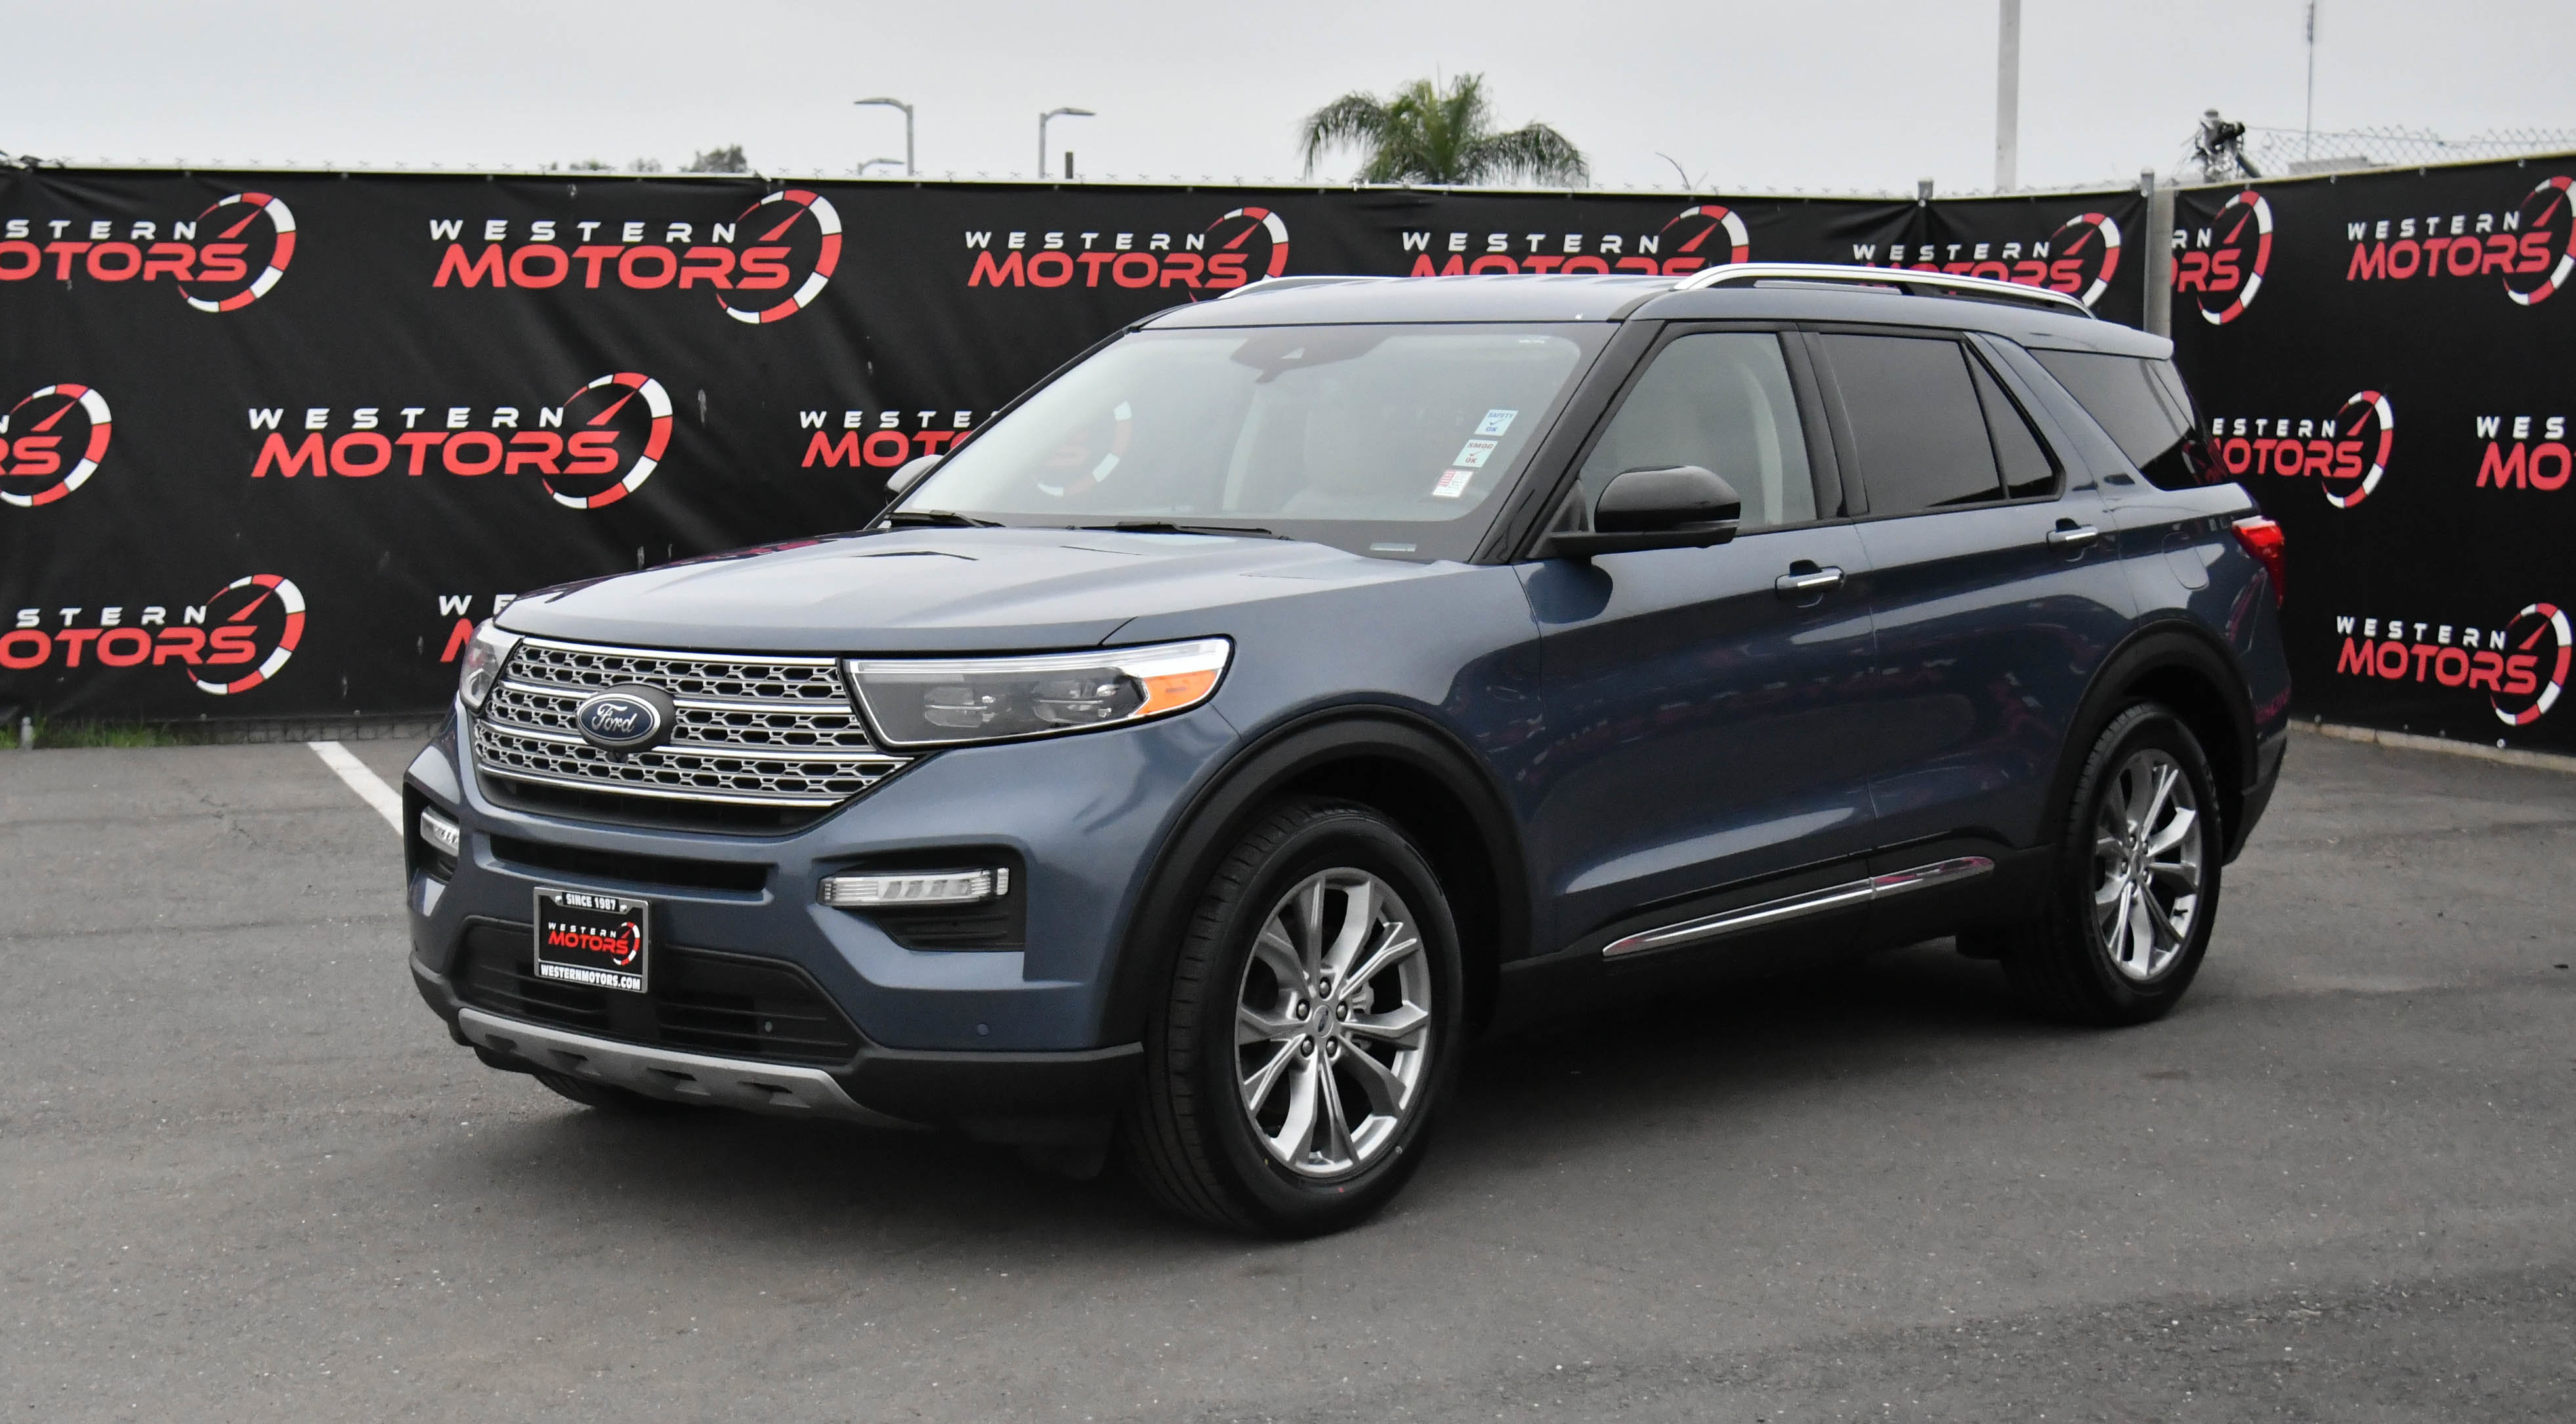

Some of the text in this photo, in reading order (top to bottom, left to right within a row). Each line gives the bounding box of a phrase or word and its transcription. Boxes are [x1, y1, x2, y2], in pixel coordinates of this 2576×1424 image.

[429, 219, 736, 243] WESTERN
[965, 231, 1205, 251] WESTERN
[2348, 211, 2520, 241] WESTERN
[1403, 232, 1659, 254] WESTERN
[1853, 241, 2050, 261] WESTERN
[2348, 231, 2553, 281] MOTORS
[433, 243, 792, 289] MOTORS
[967, 250, 1249, 289] MOTORS
[2170, 248, 2242, 293] RS
[248, 407, 564, 430] WESTERN
[799, 411, 999, 429] WESTE
[251, 430, 620, 478] MOTORS
[801, 430, 973, 468] MOT
[2214, 438, 2364, 478] OTORS
[2476, 441, 2576, 491] MO
[2336, 616, 2506, 650] WESTERN
[2337, 637, 2538, 694] MOTORS
[591, 703, 638, 733] Ford
[566, 893, 616, 911] SINCE 1987
[548, 922, 617, 938] WESTERN
[548, 929, 629, 955] MOTORS
[540, 964, 641, 990] WESTERNMOTORS.COM
